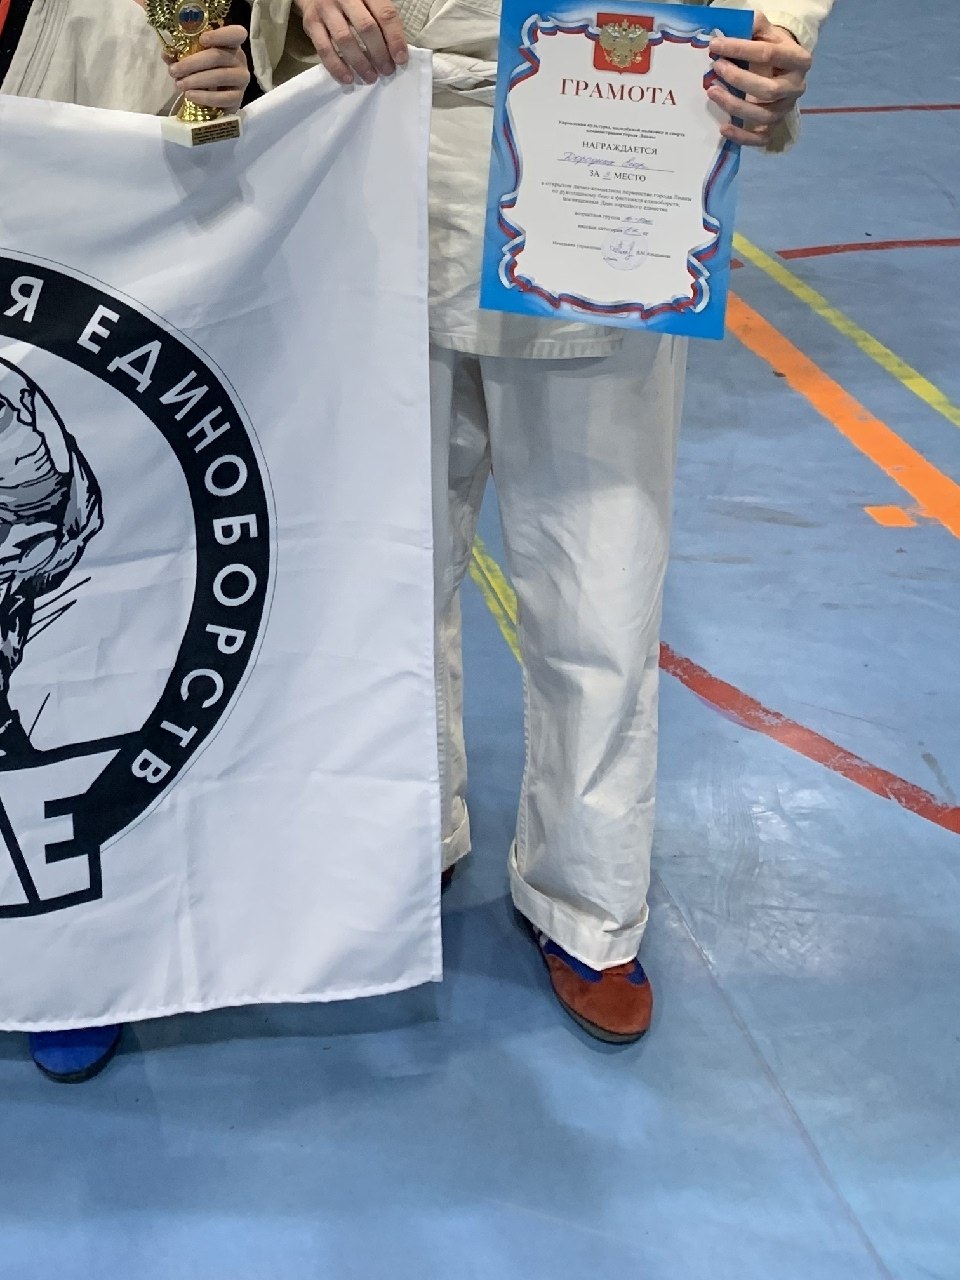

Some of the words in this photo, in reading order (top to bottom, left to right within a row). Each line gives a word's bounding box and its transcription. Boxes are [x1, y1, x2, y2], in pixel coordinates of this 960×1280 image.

[559, 77, 678, 107] ГРАМОТА
[582, 140, 658, 156] НАГРАЖДАЕТСЯ
[589, 170, 600, 178] ЗА
[614, 172, 647, 182] МЕСТО
[76, 303, 259, 786] ЕДИНОБОРСТВ
